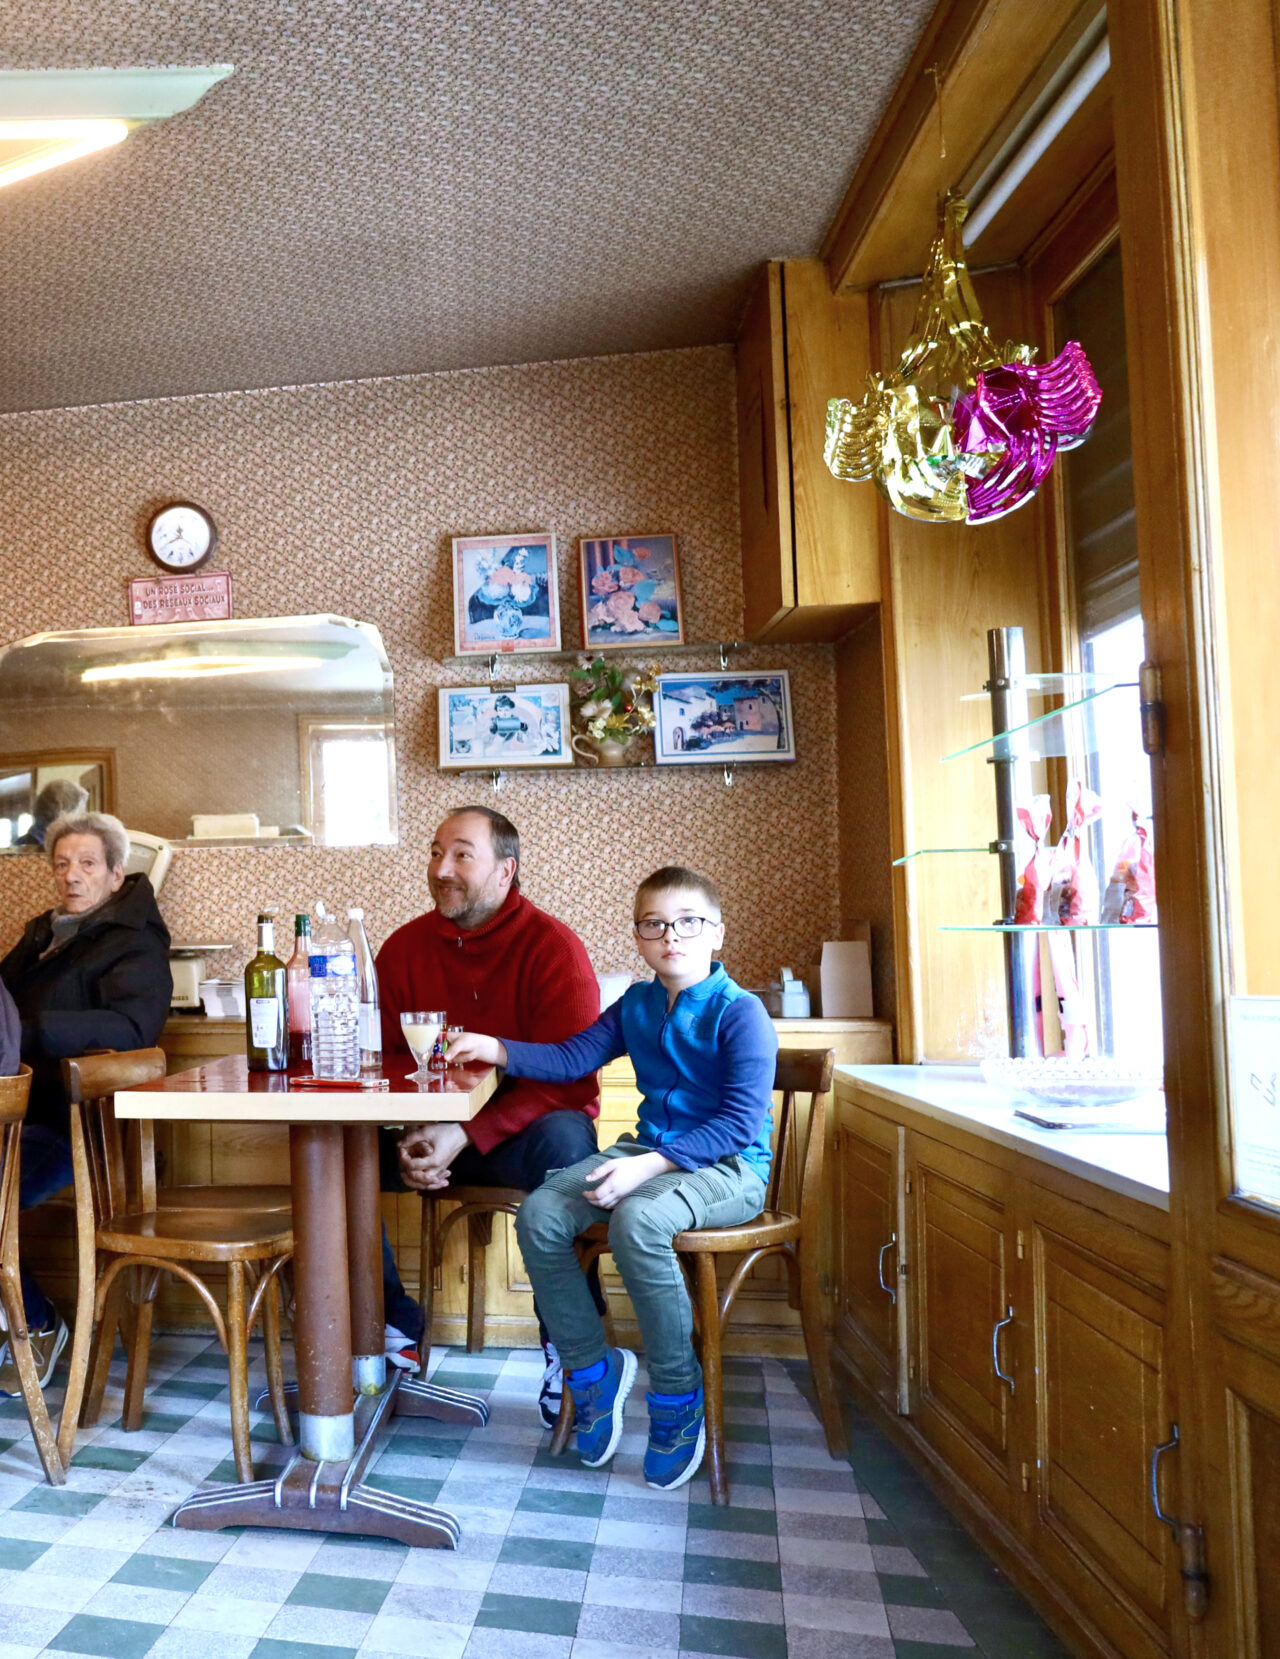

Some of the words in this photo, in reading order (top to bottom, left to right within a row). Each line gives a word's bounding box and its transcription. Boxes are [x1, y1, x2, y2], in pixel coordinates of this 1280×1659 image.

[145, 587, 156, 597] UN
[143, 599, 157, 609] DES
[194, 594, 225, 605] SOCIAUX
